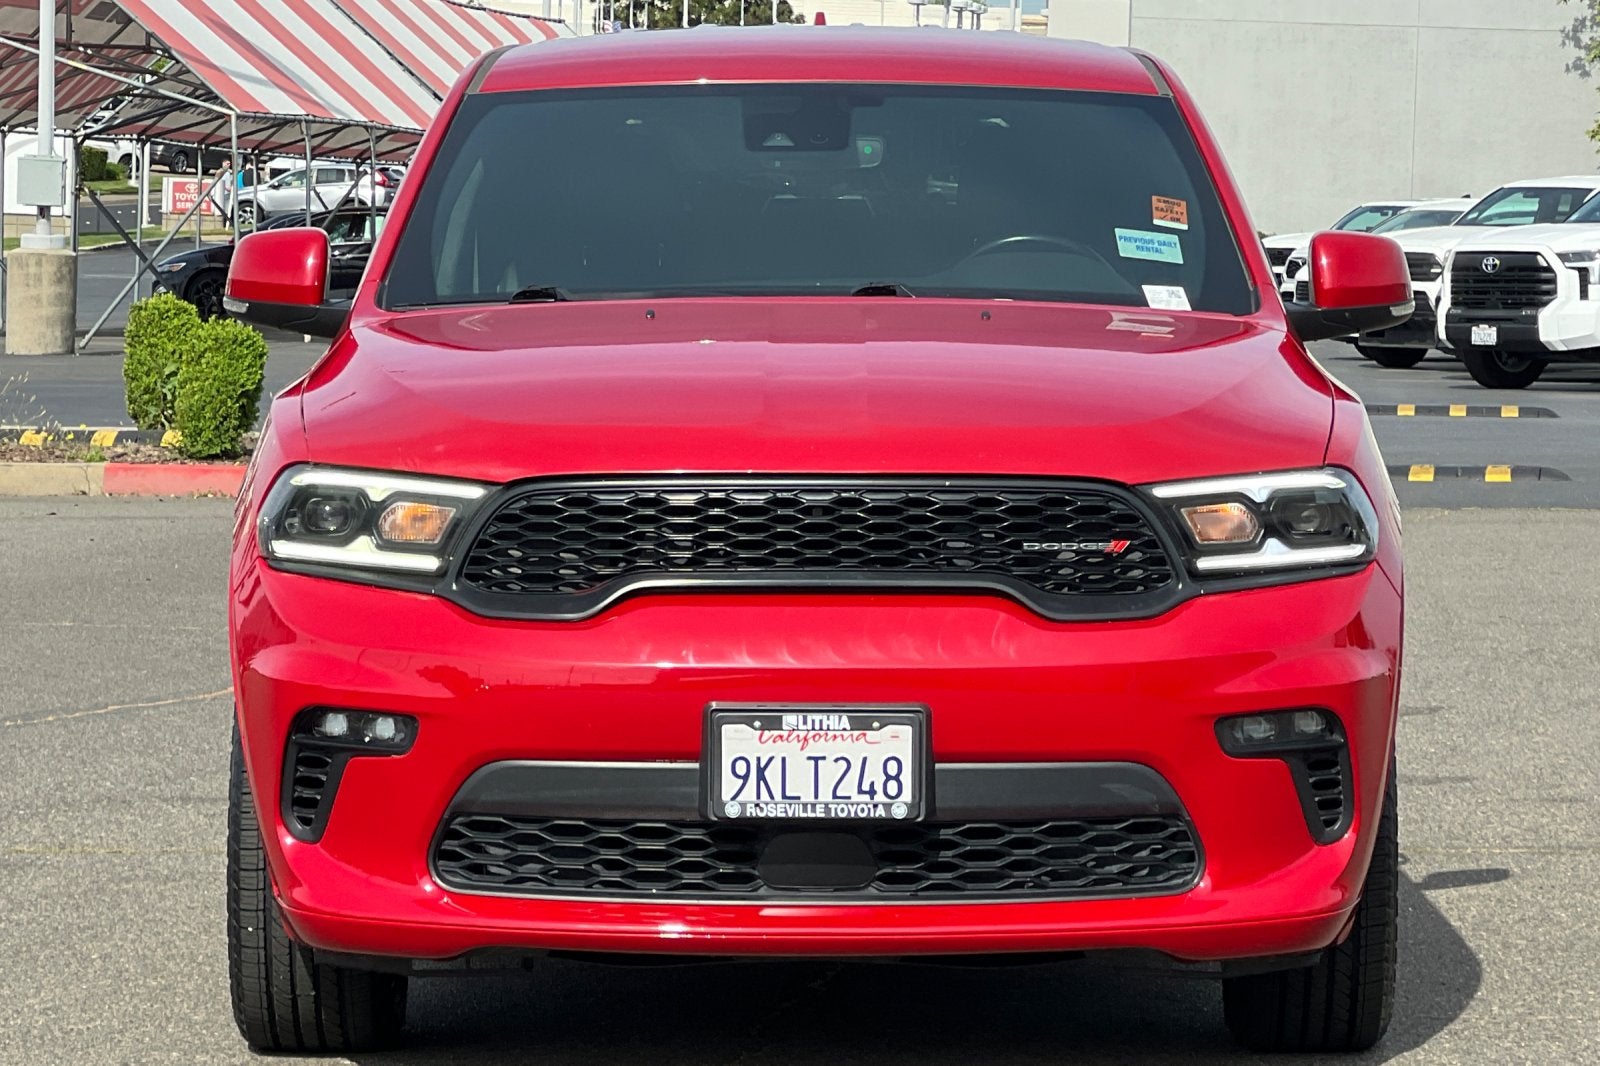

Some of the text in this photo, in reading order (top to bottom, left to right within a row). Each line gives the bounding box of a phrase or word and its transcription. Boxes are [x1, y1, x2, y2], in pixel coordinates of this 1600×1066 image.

[1154, 206, 1184, 216] SAFETY
[1118, 235, 1178, 249] PREVIOUS DAILY
[1135, 245, 1165, 255] RENTAL
[1023, 542, 1114, 550] DODGE
[797, 715, 850, 730] LITHIA
[758, 730, 881, 751] California
[730, 755, 903, 800] 9KLT248
[746, 804, 886, 817] ROSEVILLE TOYOTA
